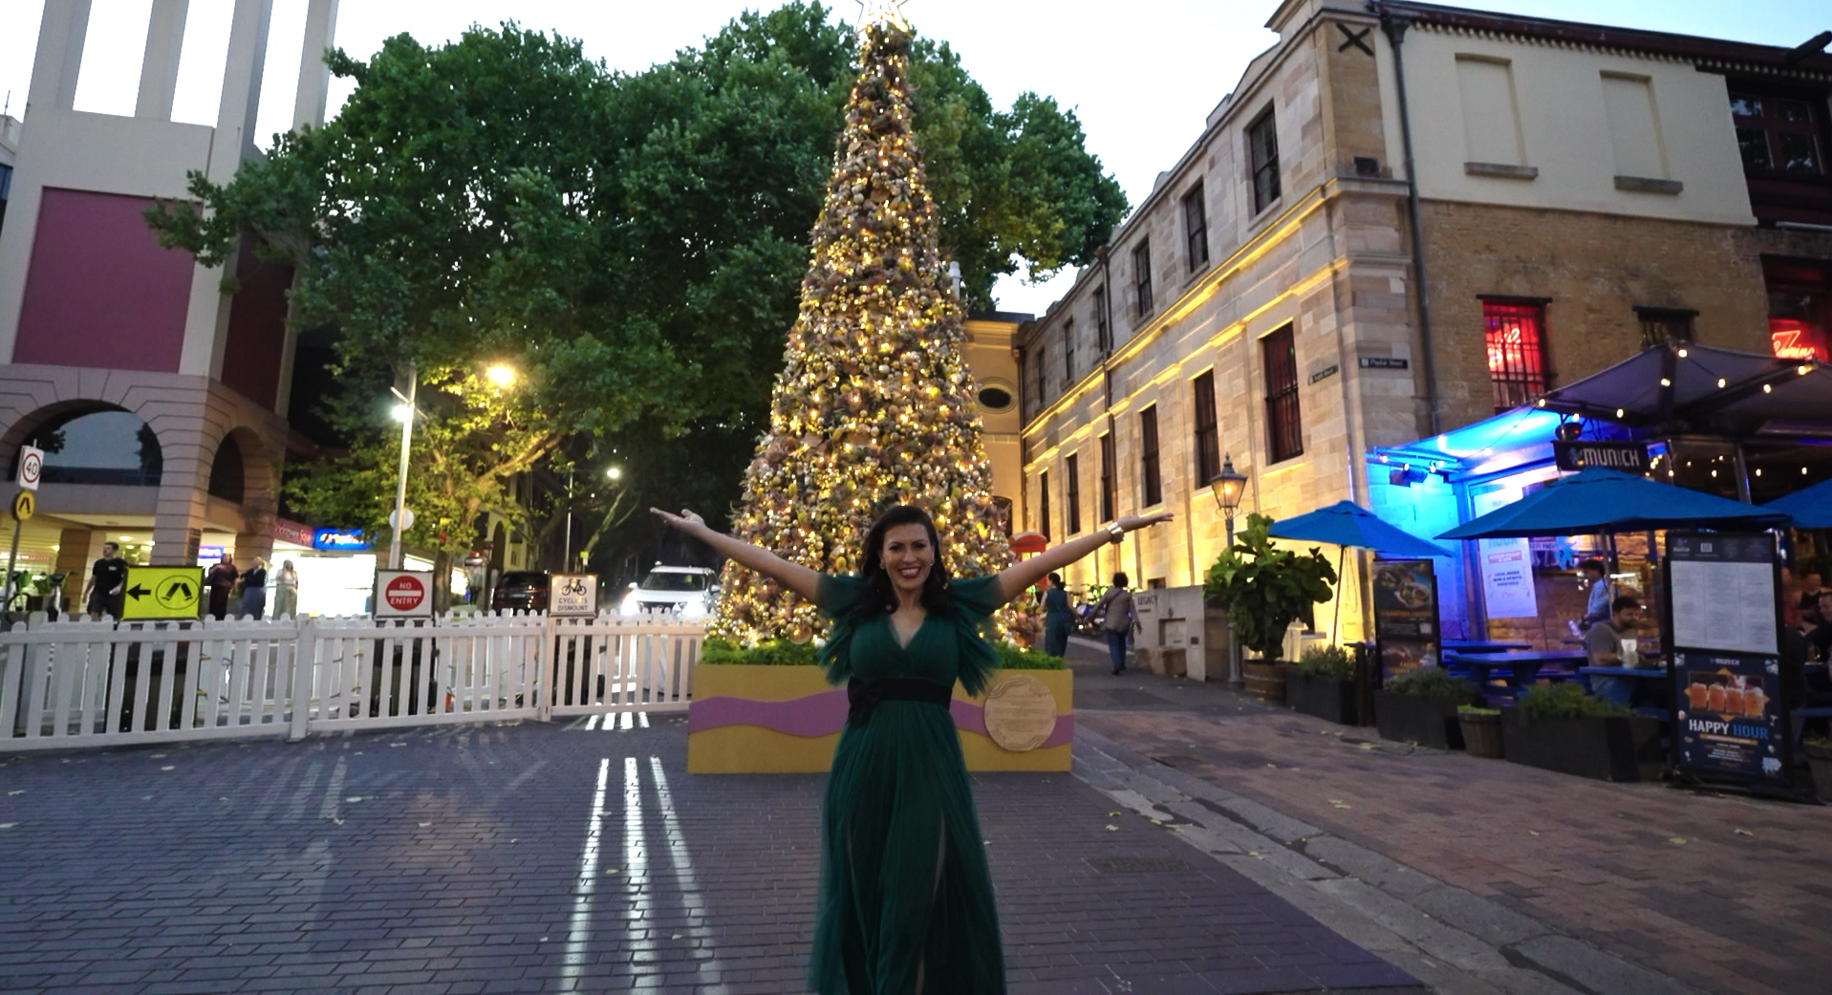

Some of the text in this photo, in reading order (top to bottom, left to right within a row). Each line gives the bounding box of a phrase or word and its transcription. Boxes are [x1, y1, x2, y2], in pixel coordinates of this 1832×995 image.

[1583, 448, 1640, 467] MUNICH
[26, 461, 38, 476] 40
[399, 582, 412, 590] NO
[390, 597, 419, 605] ENTRY
[1689, 719, 1729, 735] HAPPY
[1733, 724, 1769, 740] HOUR
